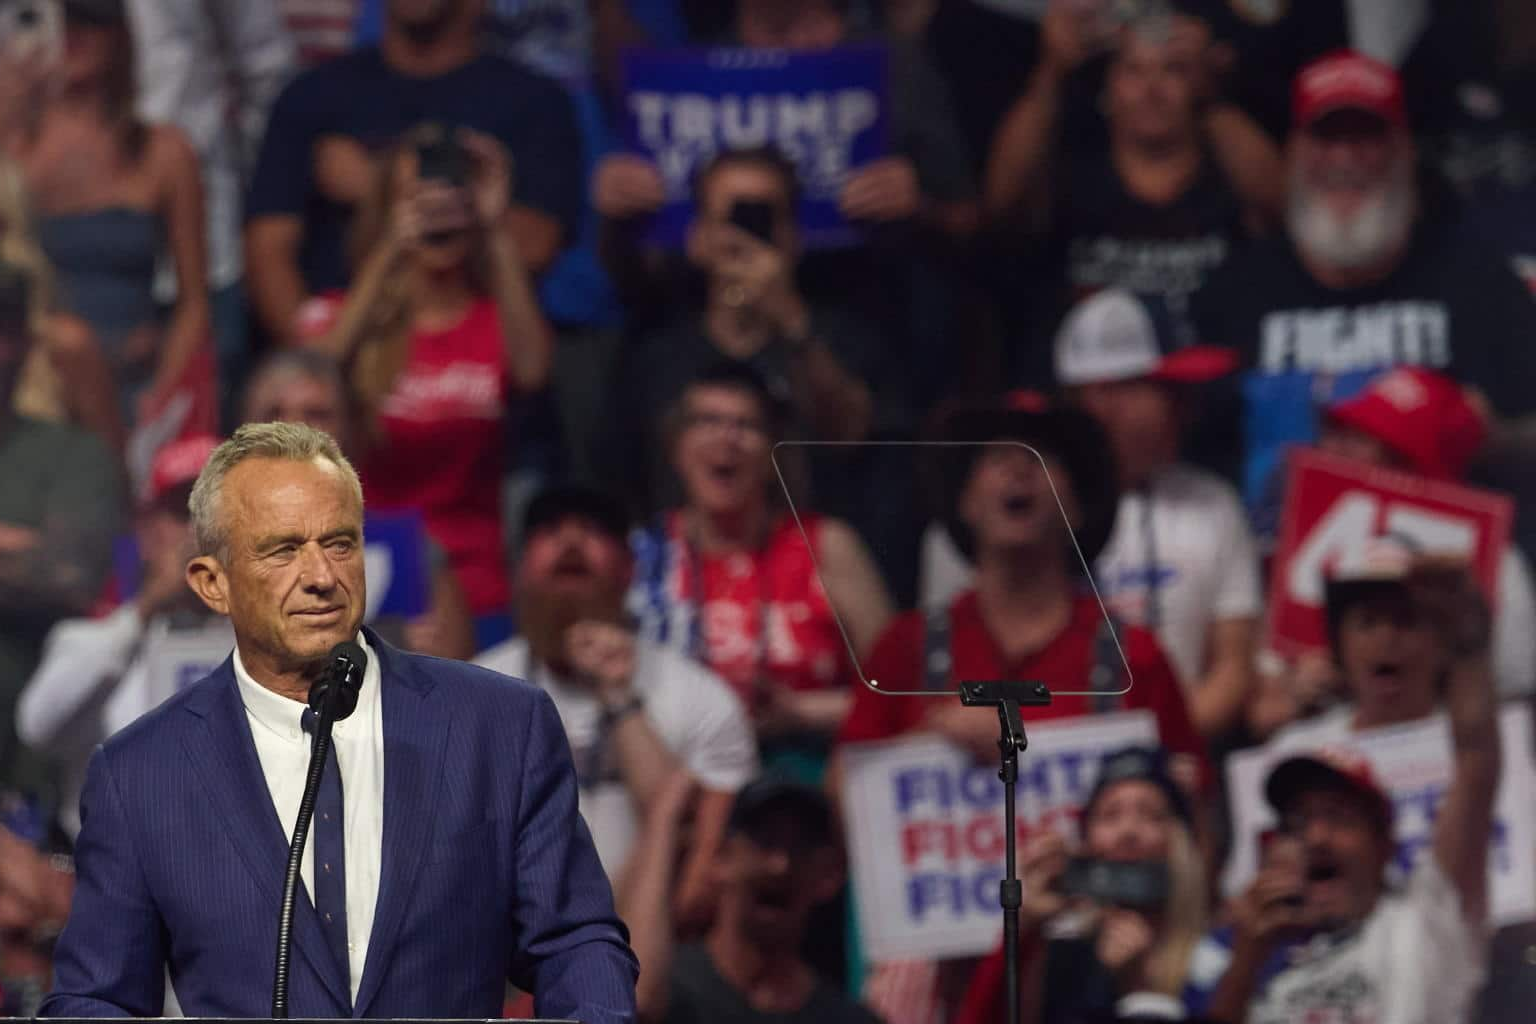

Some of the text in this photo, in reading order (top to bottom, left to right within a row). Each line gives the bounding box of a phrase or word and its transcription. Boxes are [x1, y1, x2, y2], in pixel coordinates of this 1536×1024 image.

[628, 88, 878, 155] TRUMP
[1261, 300, 1451, 375] FIGHT!
[908, 866, 1005, 923] FIG
